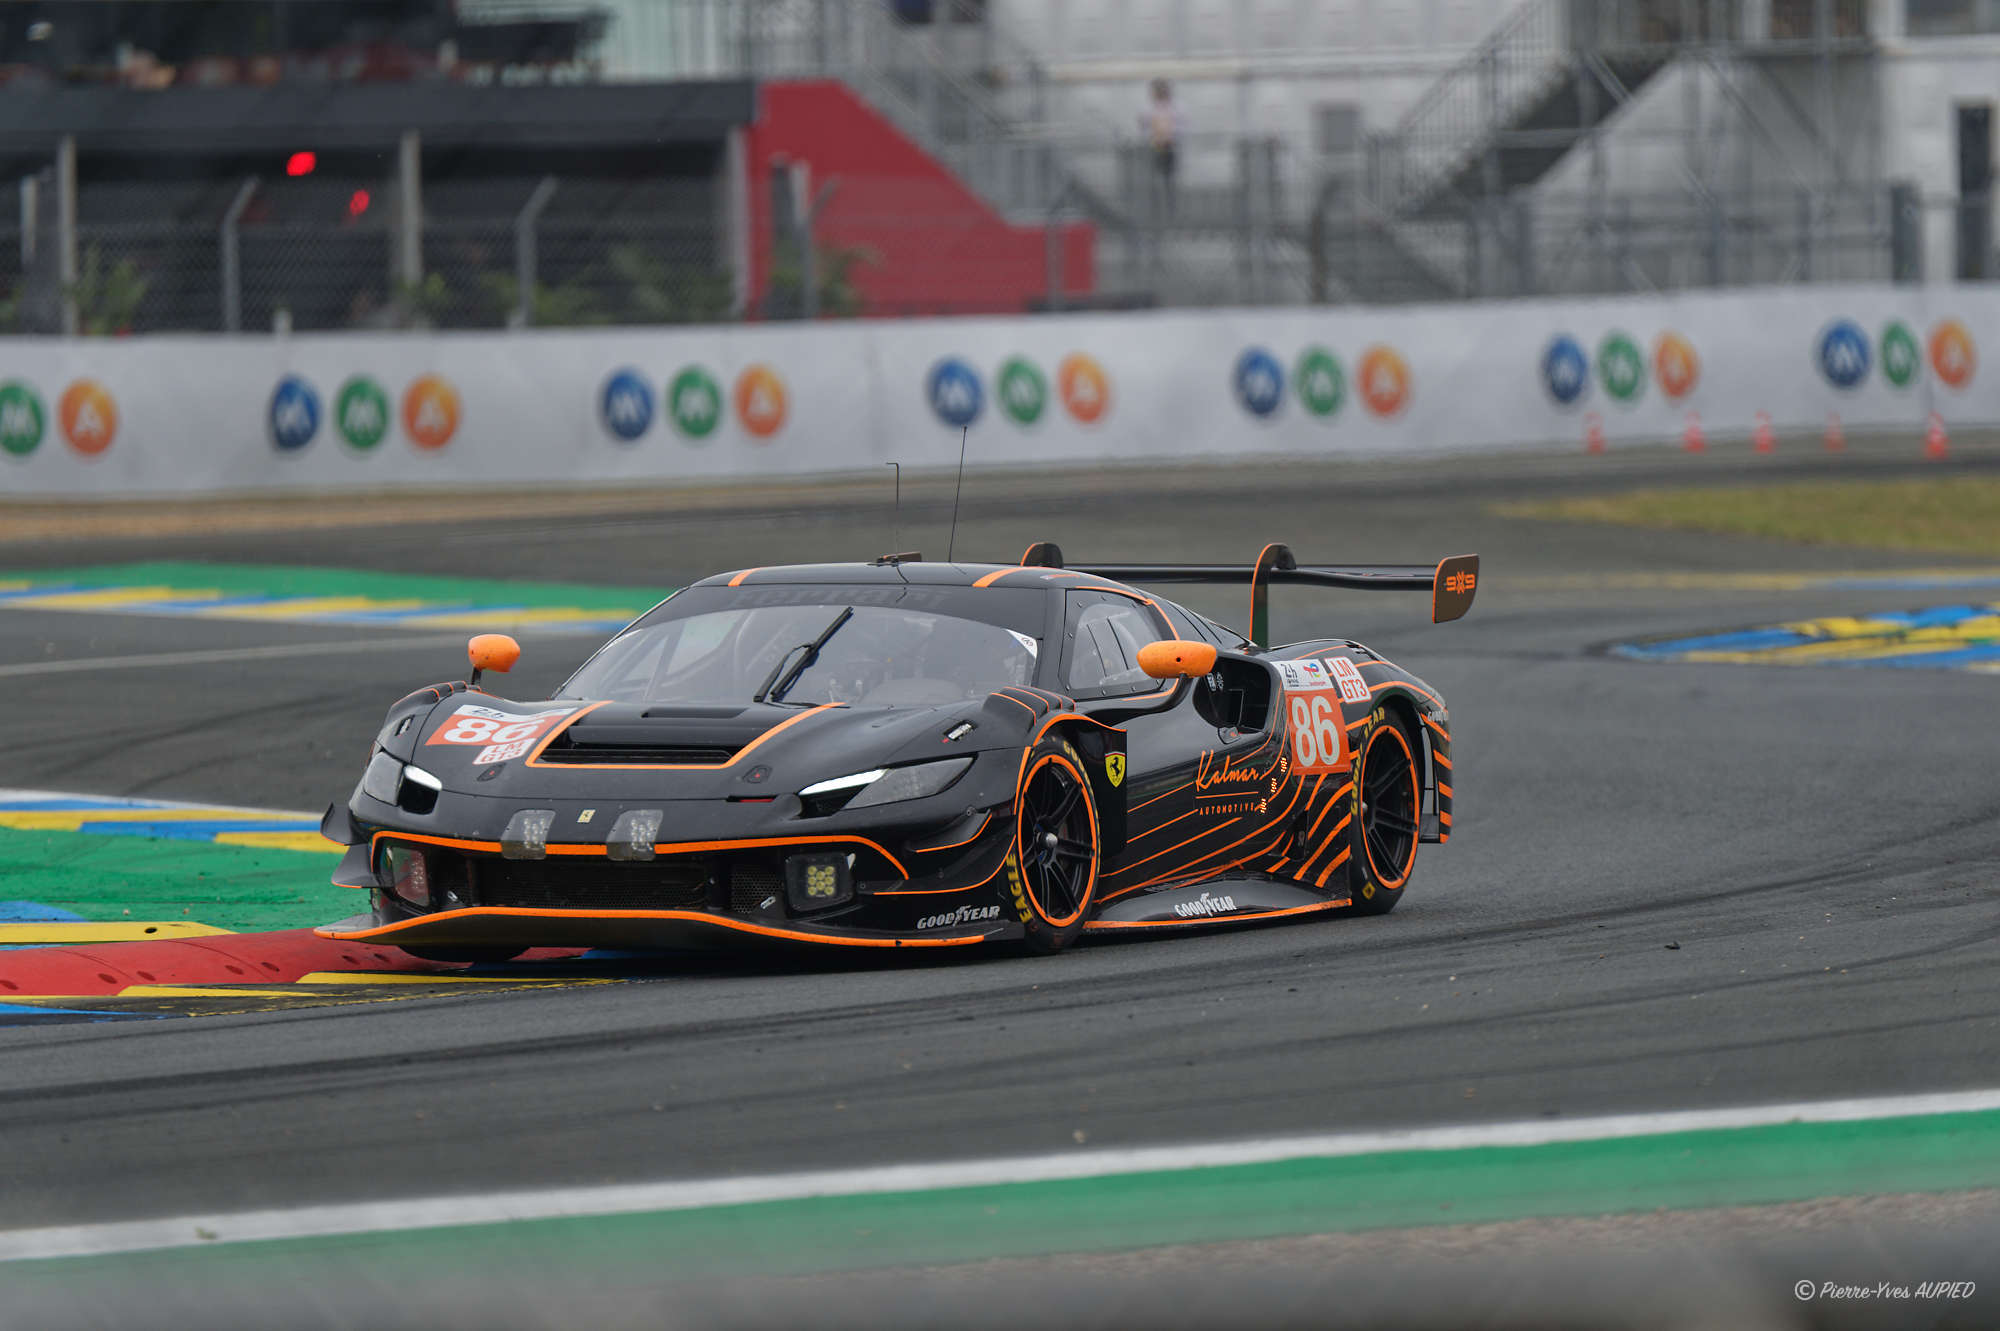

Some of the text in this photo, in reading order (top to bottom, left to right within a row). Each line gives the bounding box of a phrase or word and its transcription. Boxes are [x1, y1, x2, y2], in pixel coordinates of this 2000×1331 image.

[1330, 659, 1355, 677] LM
[1341, 679, 1367, 700] GT3
[444, 718, 545, 743] 86
[1292, 695, 1340, 767] 86
[491, 742, 523, 753] LM
[1196, 749, 1259, 792] Kalmar
[1200, 802, 1254, 816] AUTOMOTIVE
[1006, 852, 1032, 923] EAGLE
[1174, 892, 1237, 917] GOODYEAR
[917, 905, 1000, 929] GOODYEAR
